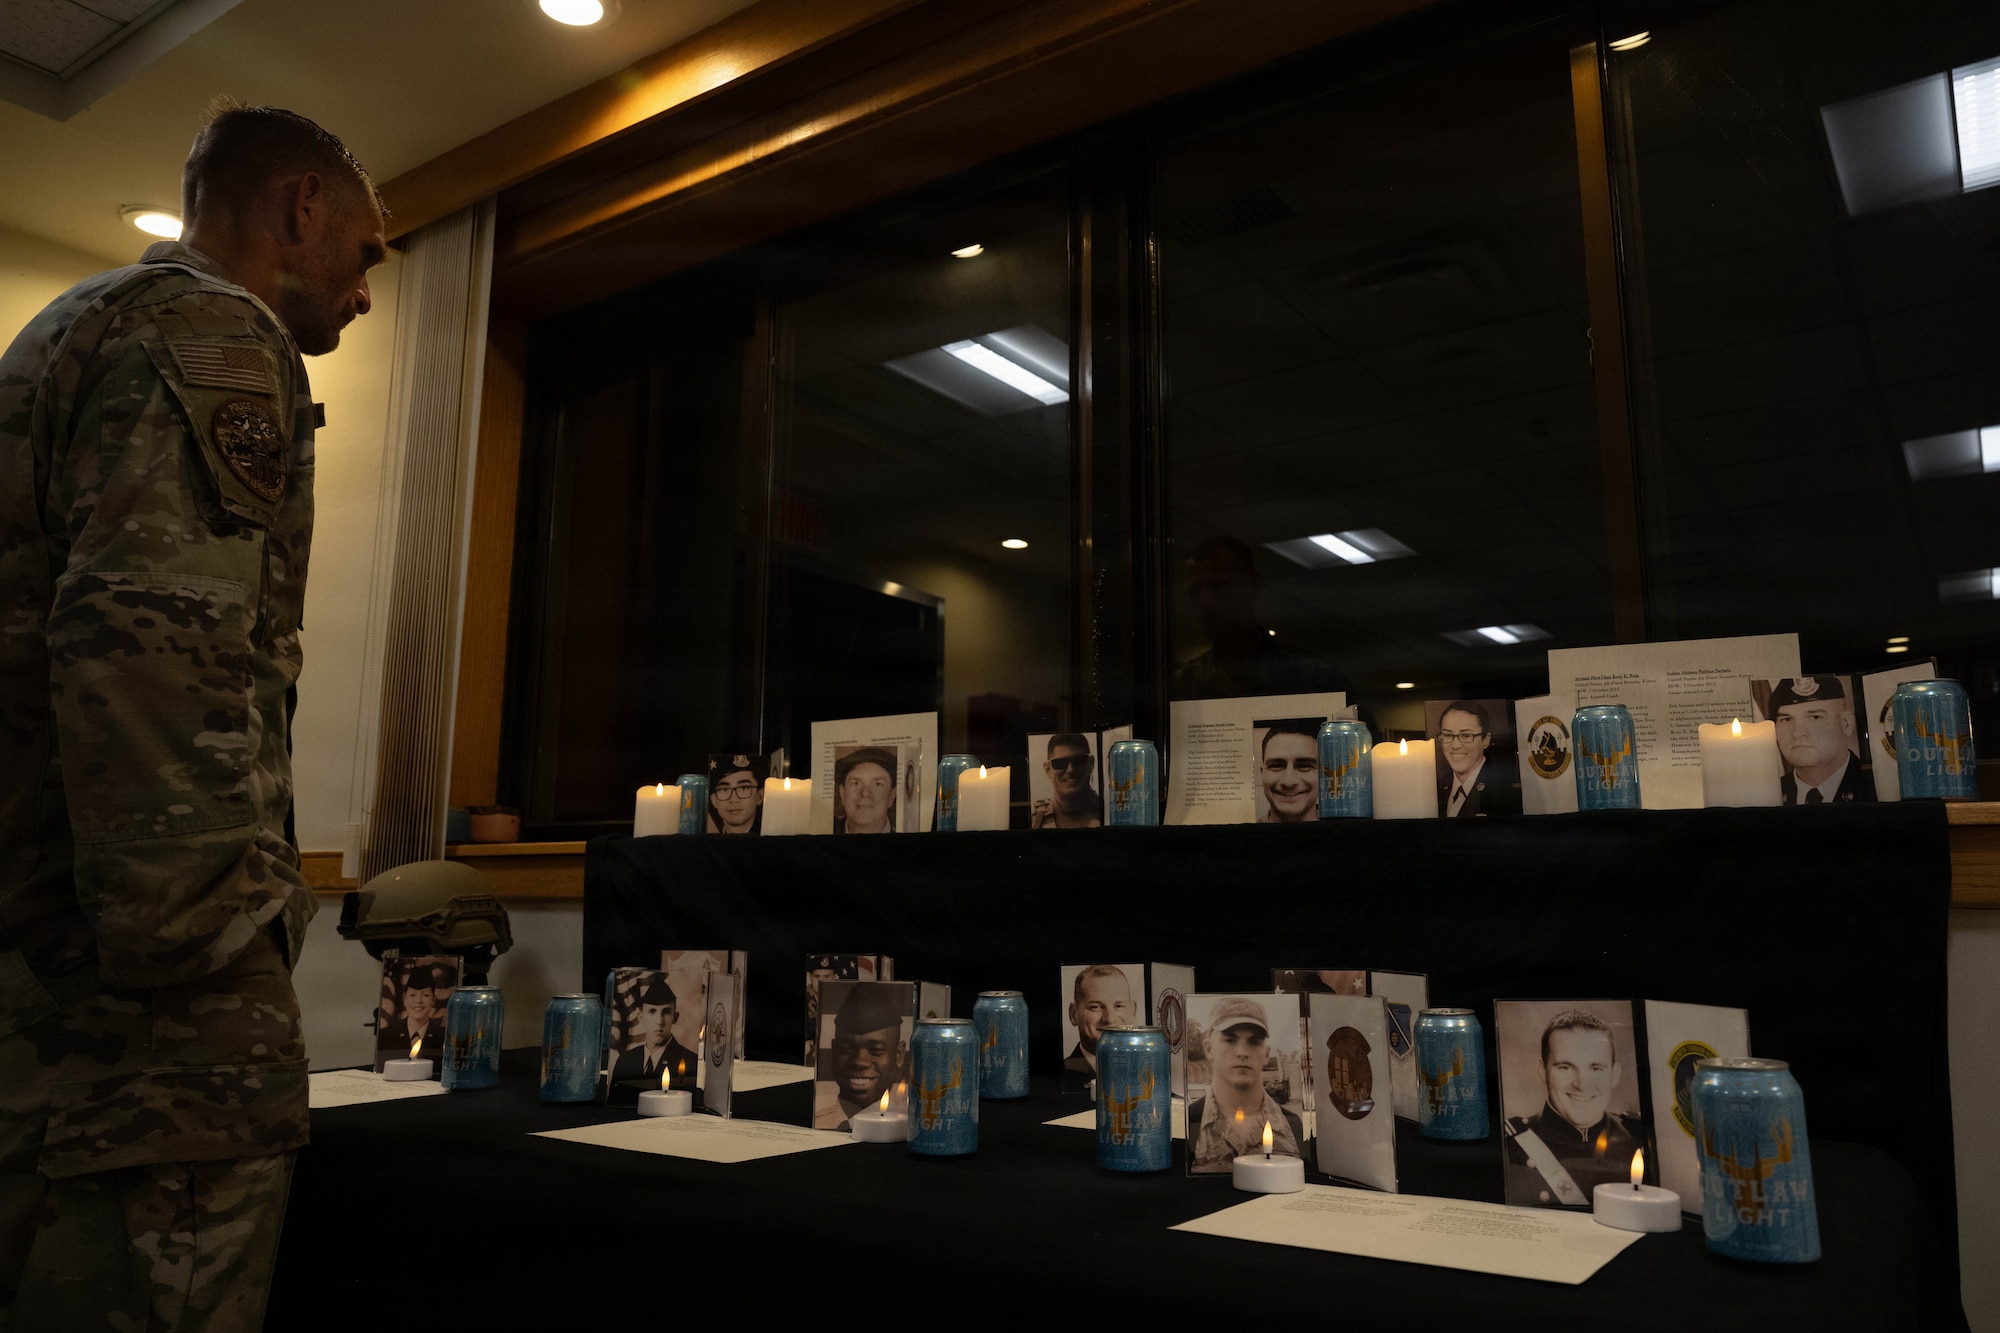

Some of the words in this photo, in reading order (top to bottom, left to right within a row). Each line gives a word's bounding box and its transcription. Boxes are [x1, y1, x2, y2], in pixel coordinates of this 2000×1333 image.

[228, 401, 252, 413] POLICE
[1907, 746, 1976, 763] OUTLA
[1926, 764, 1976, 776] LIGHT
[1320, 775, 1367, 790] TLAW
[1588, 780, 1630, 791] LIGHT
[911, 1098, 971, 1115] UTLAW
[1101, 1111, 1164, 1129] UTLAW
[1100, 1132, 1149, 1147] LIGHT
[1703, 1172, 1809, 1204] UTLAW
[1715, 1203, 1791, 1227] LIGHT
